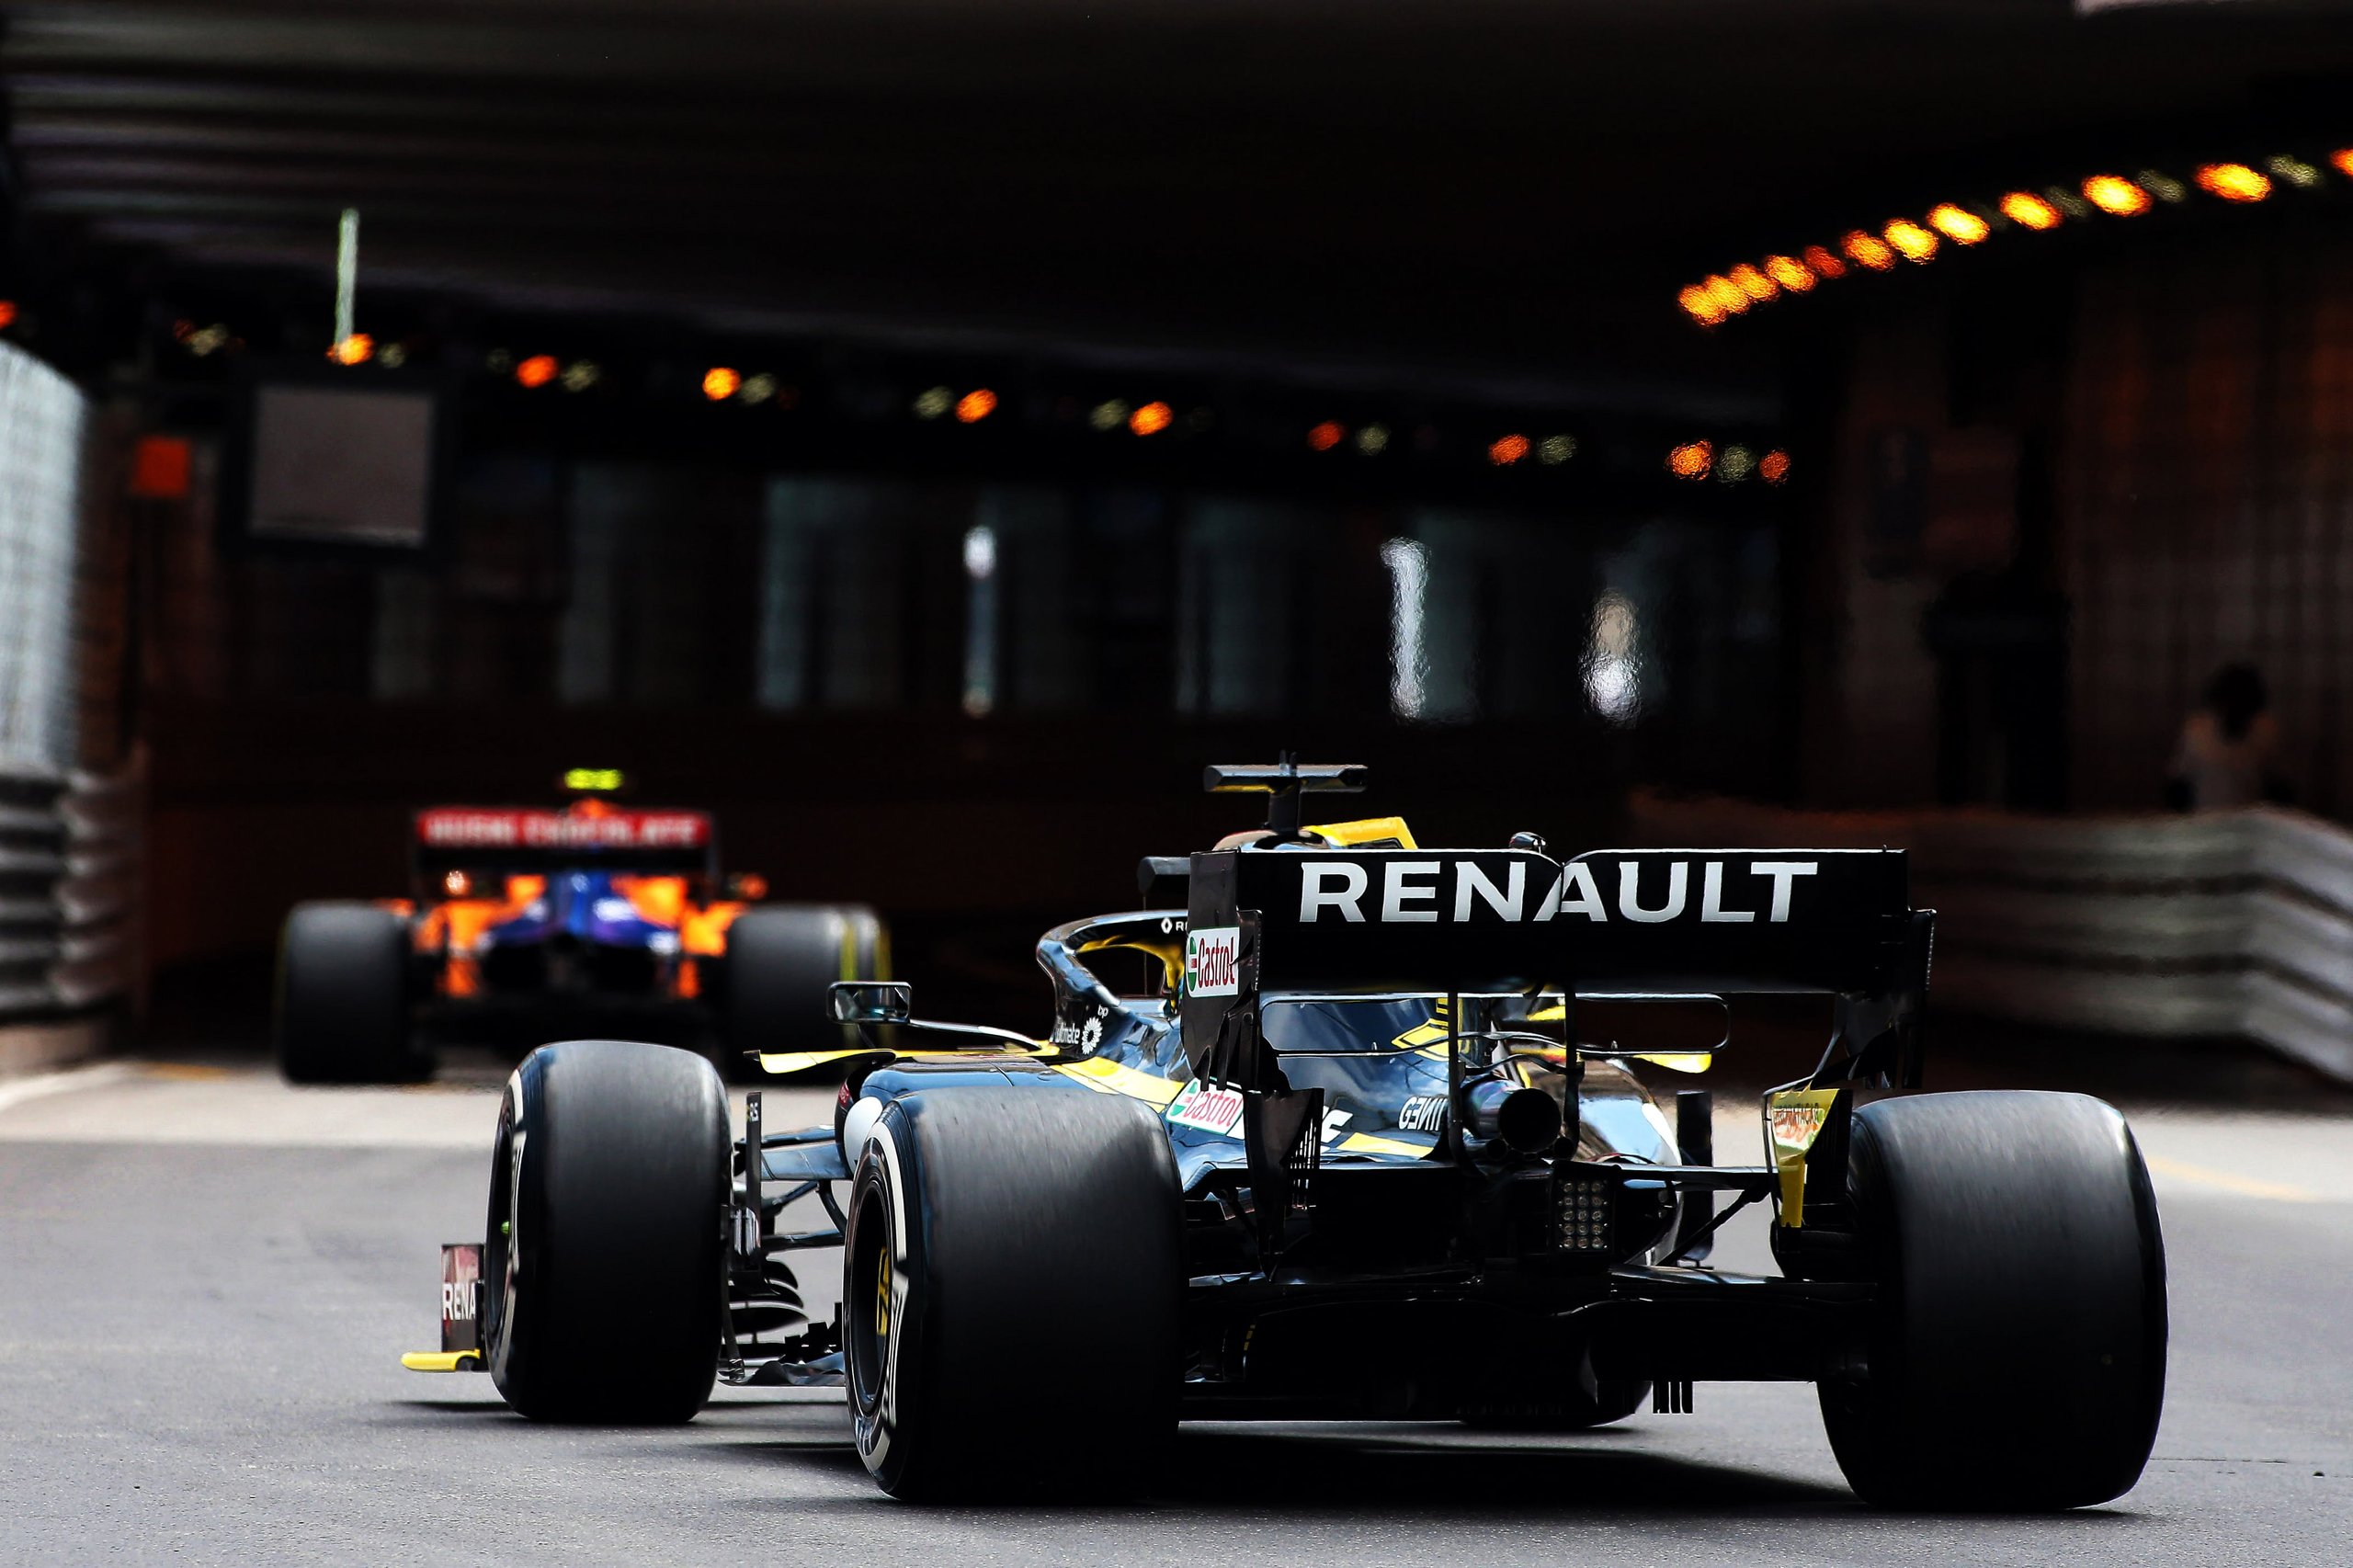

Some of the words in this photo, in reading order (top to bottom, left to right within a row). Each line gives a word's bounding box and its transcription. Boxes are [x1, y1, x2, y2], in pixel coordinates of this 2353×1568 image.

[1299, 861, 1817, 922] RENAULT
[1197, 937, 1235, 989] Castrol
[1097, 1005, 1108, 1017] bp
[1183, 1090, 1243, 1127] Castrol
